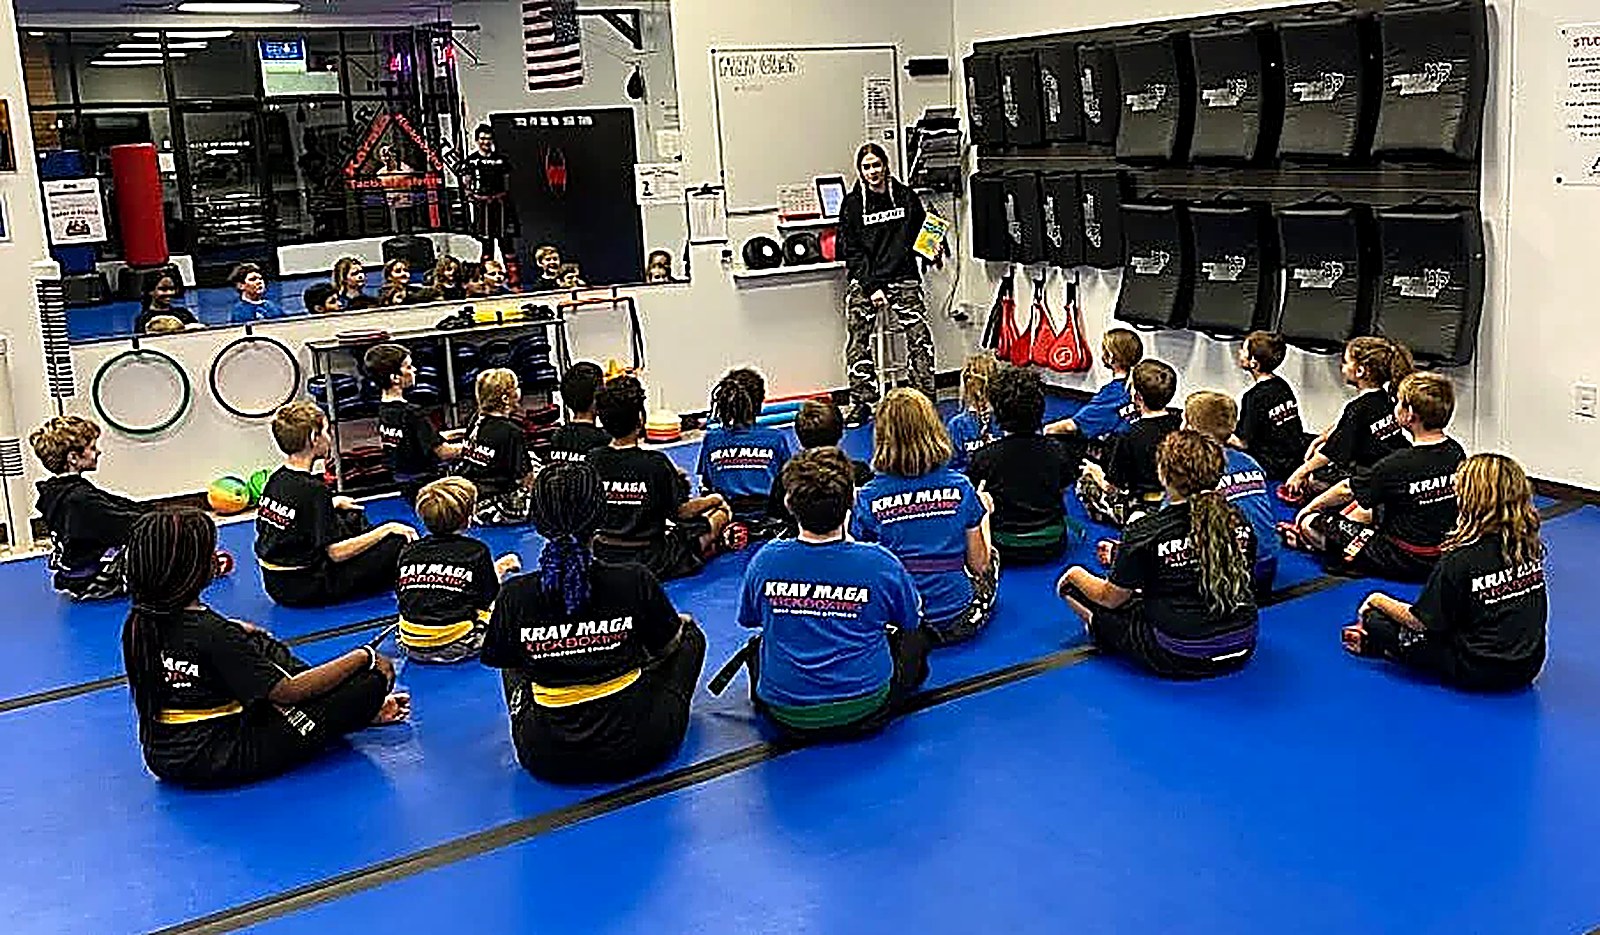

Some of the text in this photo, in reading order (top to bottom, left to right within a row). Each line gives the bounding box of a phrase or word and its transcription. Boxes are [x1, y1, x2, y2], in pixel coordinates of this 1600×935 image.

[611, 481, 648, 493] MAGA
[1409, 475, 1448, 494] KRAV
[871, 487, 961, 513] KRAV MAGA
[426, 563, 473, 583] MAGA
[1472, 567, 1513, 592] KRAV
[764, 581, 869, 603] KRAV MAGA
[520, 616, 633, 643] KRAV MAGA
[526, 631, 628, 652] KICKBOXING
[160, 657, 200, 677] AGA
